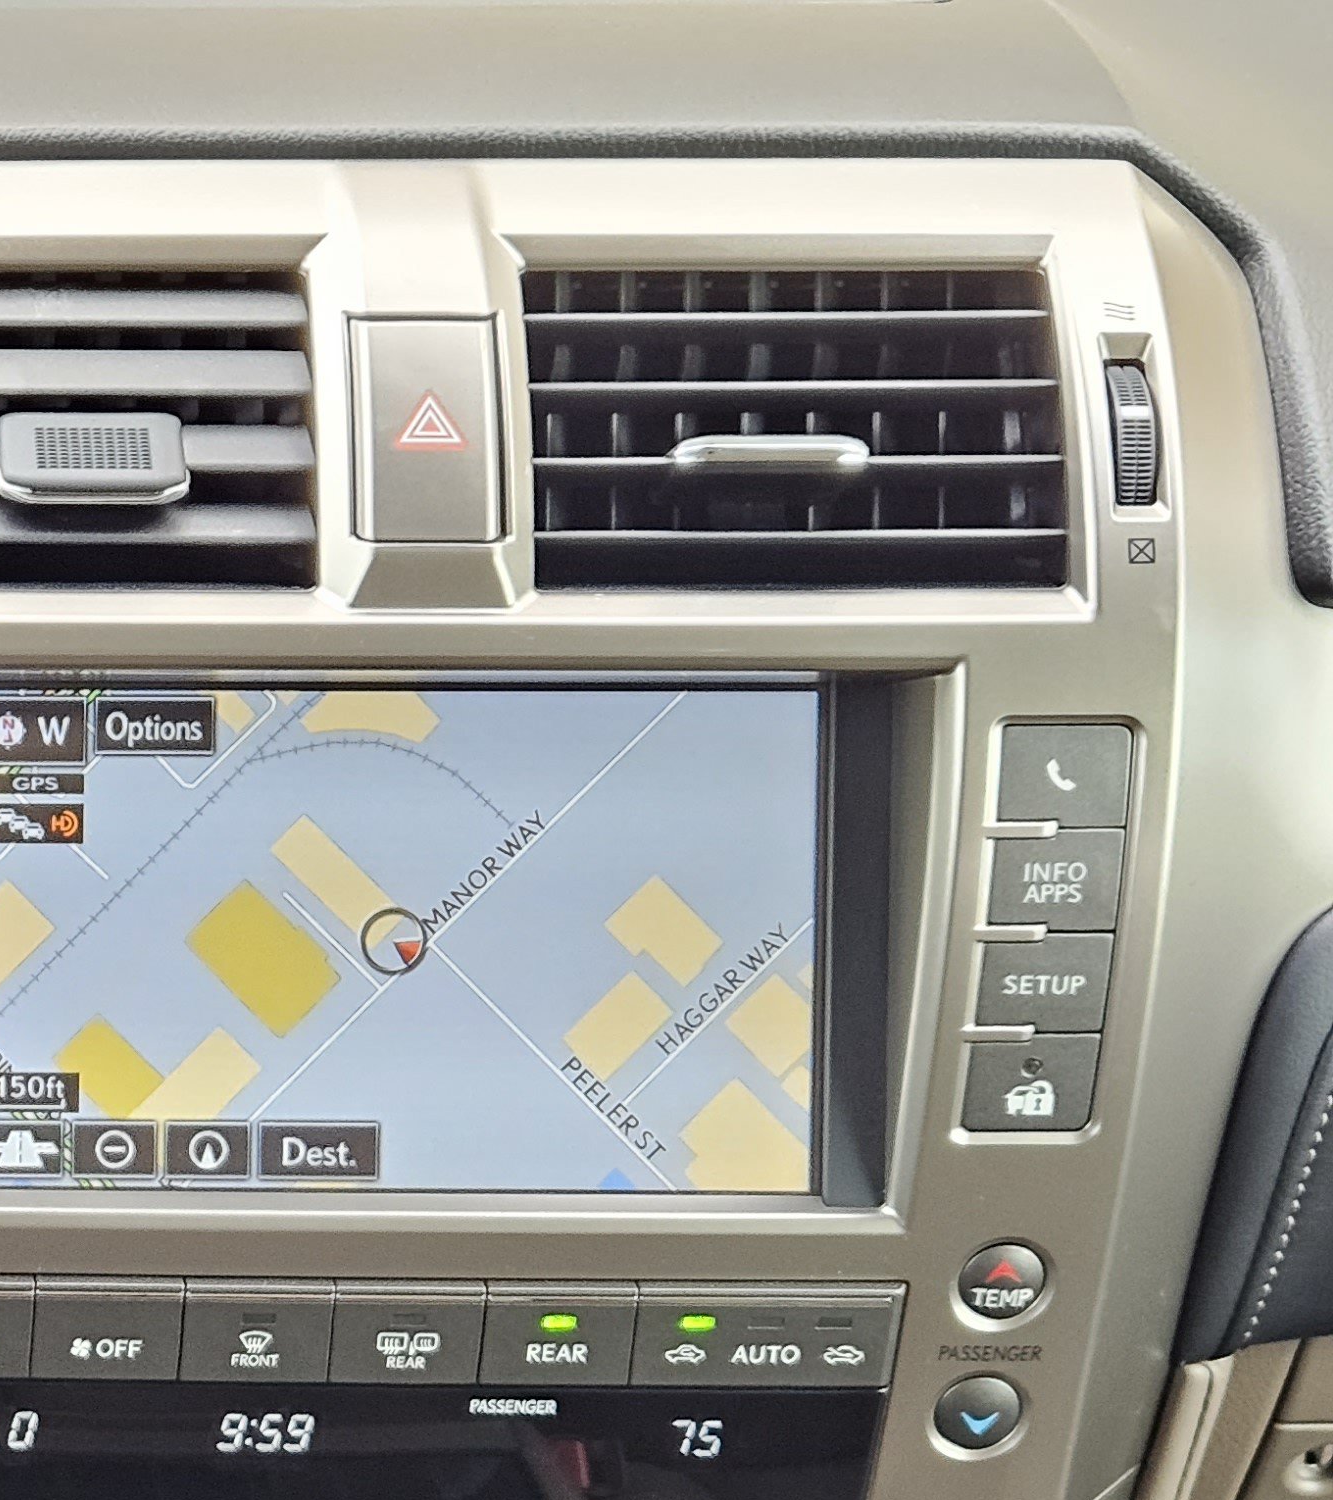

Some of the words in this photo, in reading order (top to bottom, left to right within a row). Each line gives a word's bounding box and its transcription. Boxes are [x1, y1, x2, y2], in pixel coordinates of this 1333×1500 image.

[37, 715, 71, 747] W
[105, 711, 204, 747] Options
[12, 776, 59, 792] GPS
[421, 856, 503, 935] MANOR
[496, 808, 547, 859] WAY
[1023, 862, 1089, 883] INFO
[1023, 884, 1084, 904] APPS
[654, 968, 745, 1057] HAGGAR
[738, 922, 790, 974] WAY
[1002, 976, 1087, 996] SETUP
[560, 1056, 640, 1138] PEELER
[634, 1128, 667, 1161] ST
[282, 1135, 358, 1169] Dest.
[971, 1287, 1033, 1309] TEMP
[95, 1339, 144, 1359] OFF
[526, 1343, 588, 1366] REAR
[731, 1344, 801, 1366] AUTO
[938, 1344, 1042, 1363] PASSENGER
[230, 1353, 280, 1368] FRONT
[386, 1356, 426, 1370] REAR
[468, 1398, 558, 1416] PASSENGER
[215, 1412, 316, 1454] 9:59
[672, 1418, 724, 1459] 75
